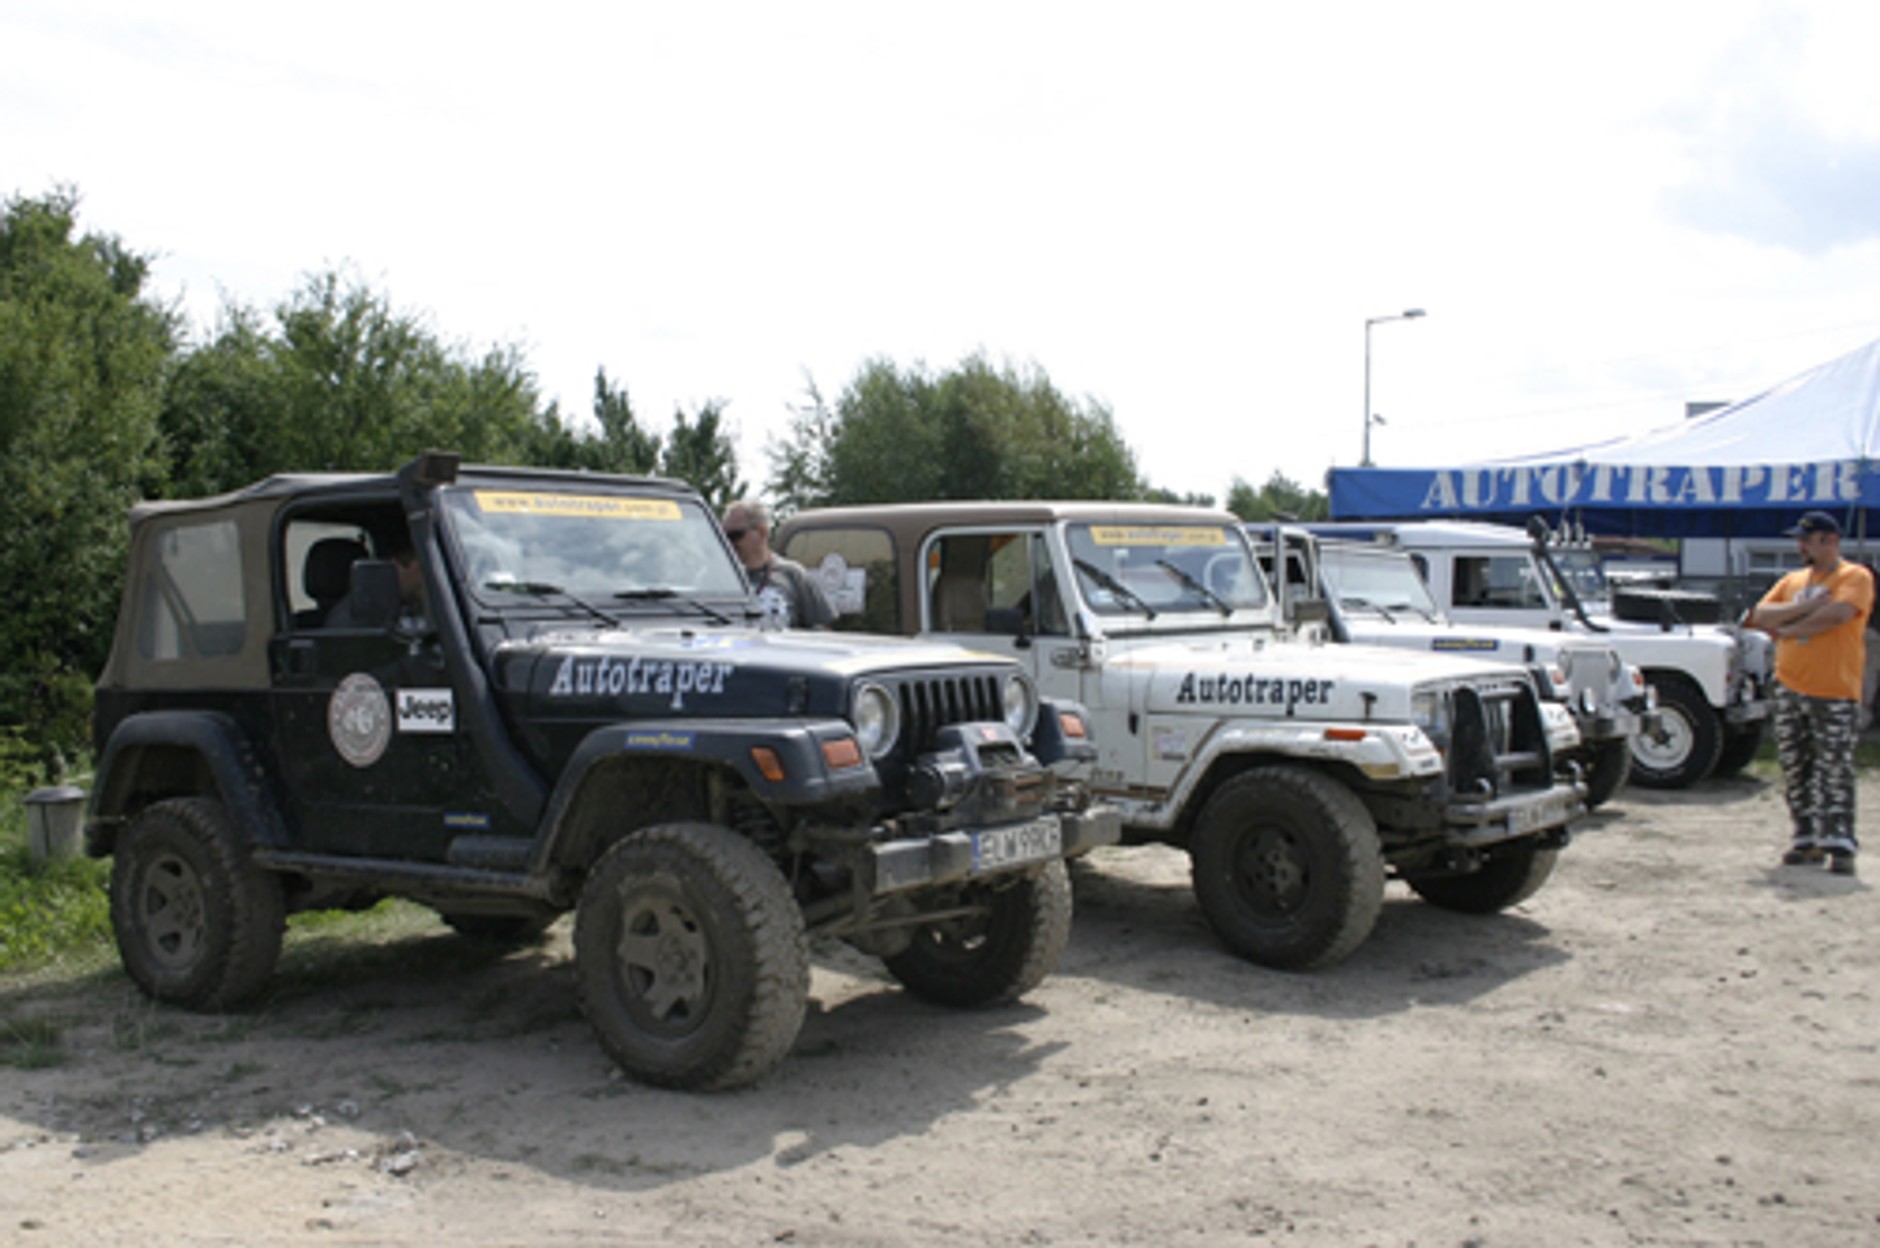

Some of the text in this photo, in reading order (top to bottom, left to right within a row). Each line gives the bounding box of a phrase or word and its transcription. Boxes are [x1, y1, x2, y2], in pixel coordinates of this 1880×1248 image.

[1420, 461, 1862, 509] AUTOTRAPER
[550, 655, 734, 709] Autotraper
[1176, 673, 1334, 717] Autotraper
[399, 695, 452, 724] Jeep
